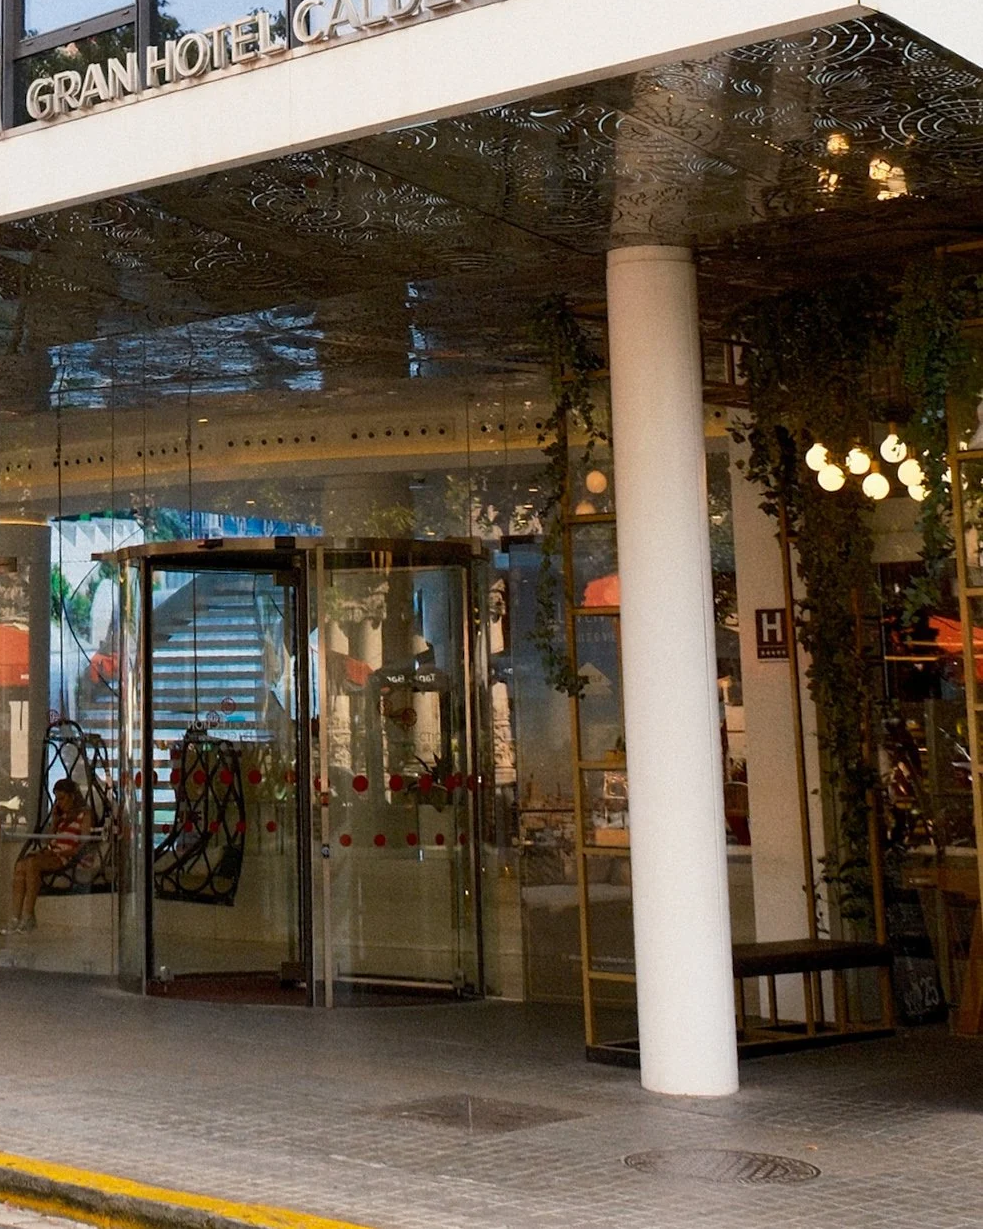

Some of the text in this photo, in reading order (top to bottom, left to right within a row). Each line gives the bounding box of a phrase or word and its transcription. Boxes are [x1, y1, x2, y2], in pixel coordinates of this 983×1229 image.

[26, 51, 143, 121] GRAN
[145, 11, 287, 88] HOTEL
[761, 611, 783, 643] H
